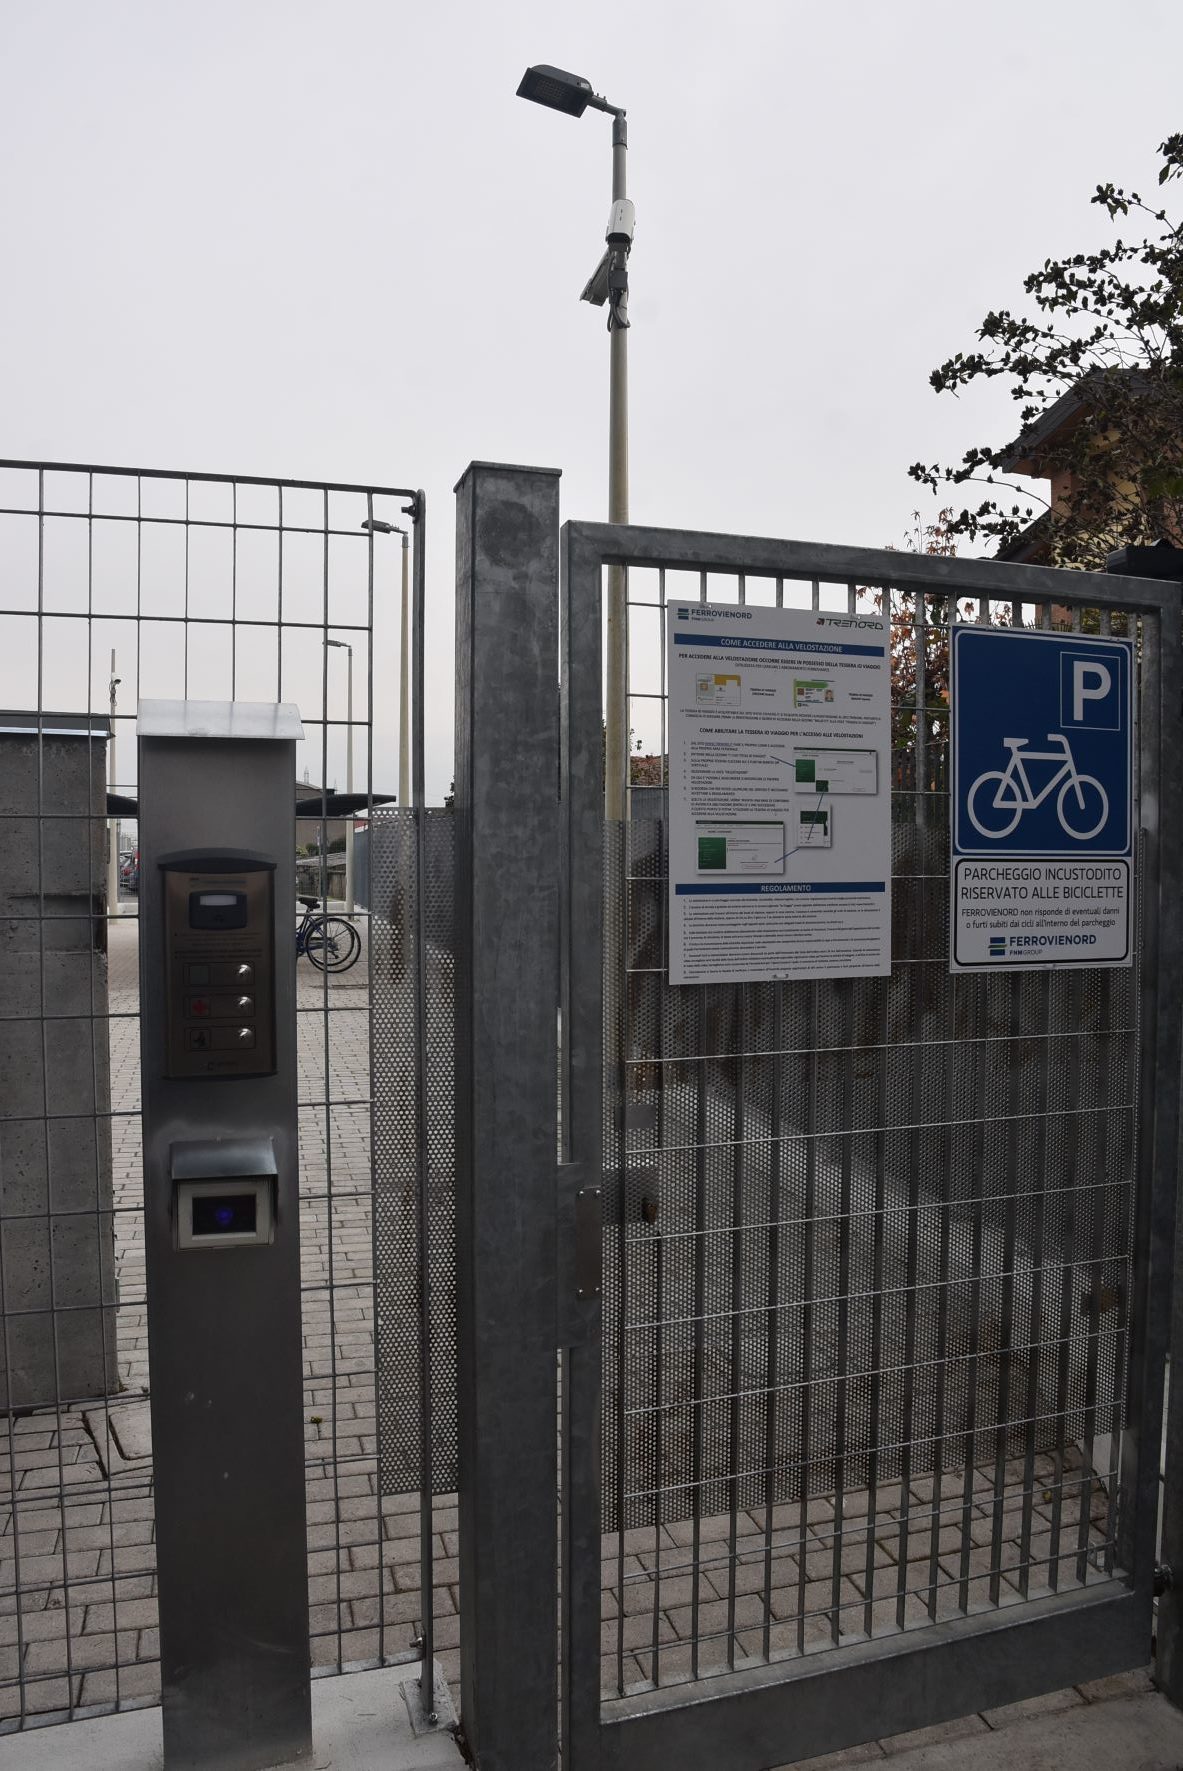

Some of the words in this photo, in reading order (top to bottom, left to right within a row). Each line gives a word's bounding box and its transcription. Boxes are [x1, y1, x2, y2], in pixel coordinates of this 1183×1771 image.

[691, 608, 752, 620] FERROVIENORD
[720, 638, 741, 646] COME
[743, 640, 777, 649] ACCEDERE
[778, 642, 794, 650] ALLA
[795, 643, 843, 653] VELOSTAZIONE
[1073, 661, 1112, 721] P
[964, 868, 1041, 881] PARCHEGGIO
[1045, 868, 1121, 880] INCUSTODITO
[961, 887, 1028, 900] RISERVATO
[1032, 887, 1059, 899] ALLE
[1063, 886, 1124, 899] BICICLETTE
[961, 909, 1018, 917] FERROVIENORD
[1034, 908, 1063, 919] risponde
[1064, 907, 1071, 916] di
[1072, 906, 1101, 915] eventuali
[1103, 906, 1120, 915] danni
[972, 919, 988, 929] furti
[989, 919, 1008, 928] subiti
[1009, 918, 1020, 928] dai
[1070, 917, 1081, 927] del
[1082, 917, 1115, 928] parcheggio
[1009, 935, 1097, 946] FERROVIENORD
